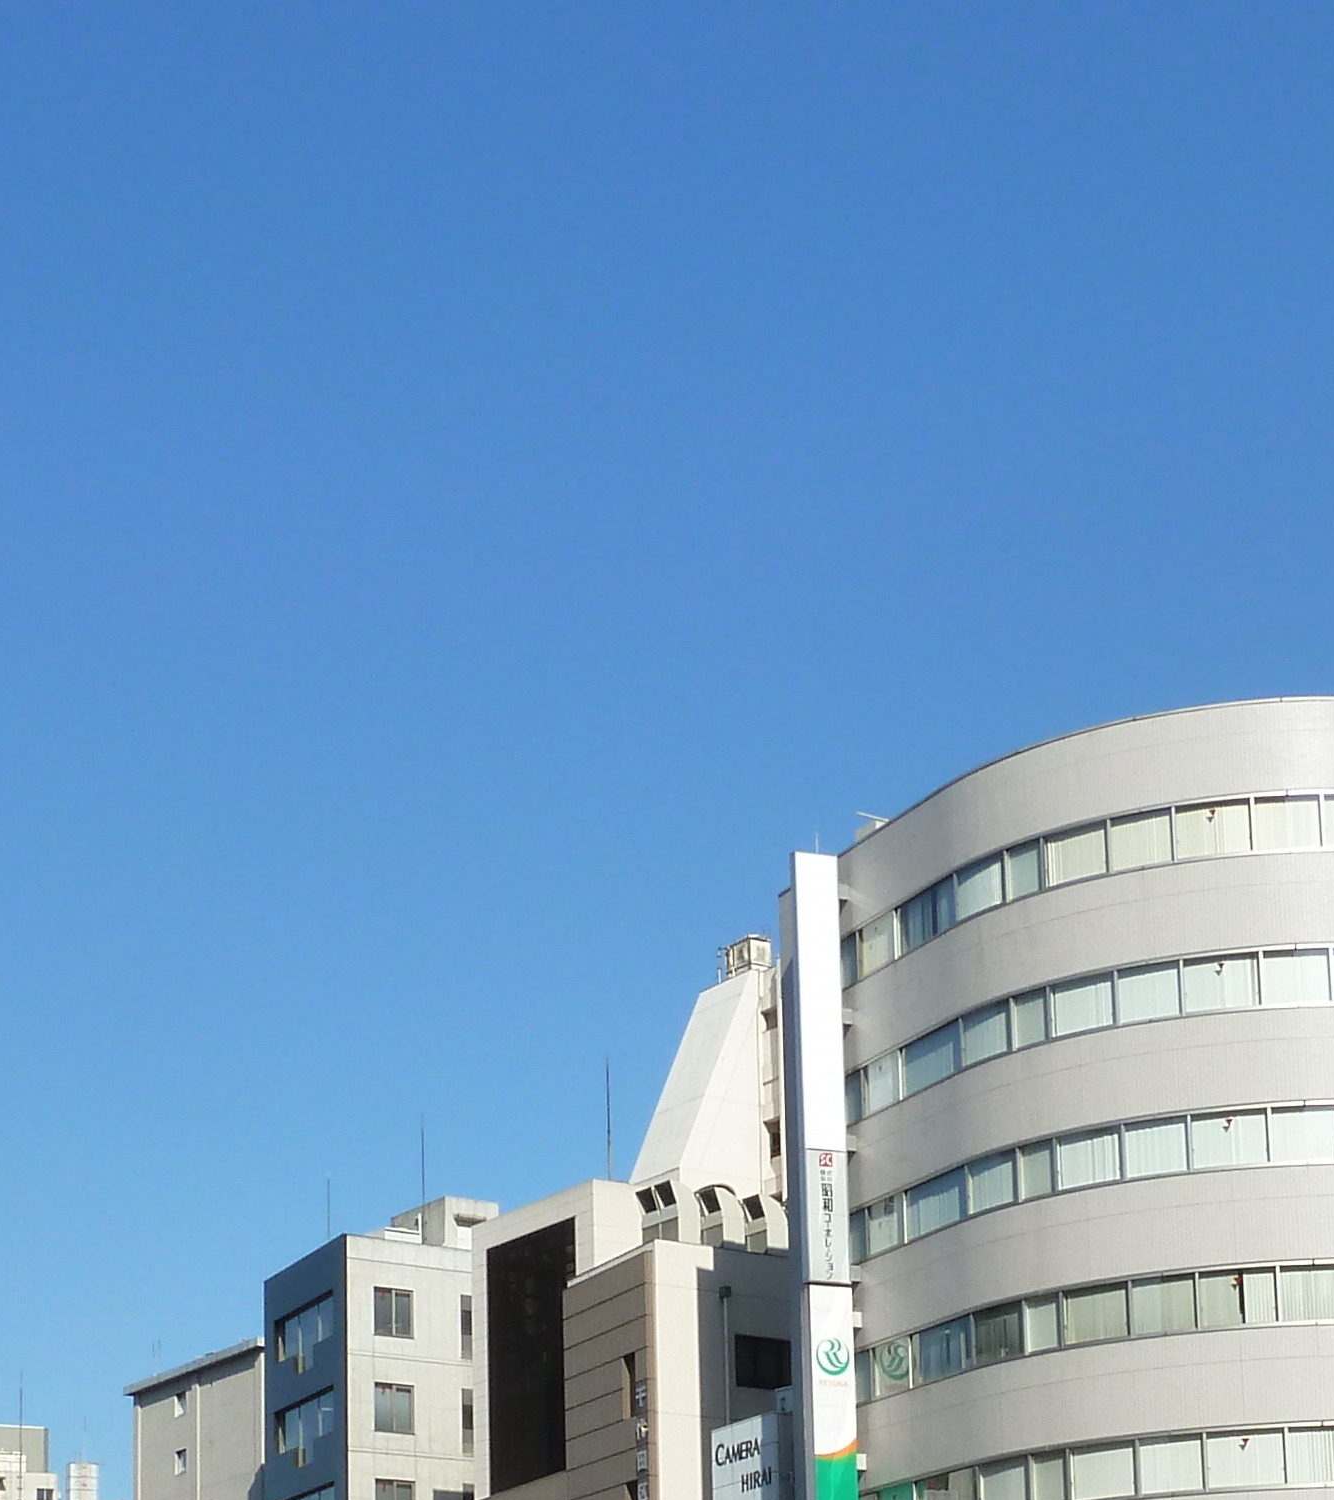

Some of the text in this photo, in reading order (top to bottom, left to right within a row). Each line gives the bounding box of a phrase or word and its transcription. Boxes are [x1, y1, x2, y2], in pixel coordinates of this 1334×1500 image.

[818, 1379, 848, 1387] RESONA
[715, 1438, 760, 1467] CAMERA
[741, 1470, 772, 1493] HIRAI
